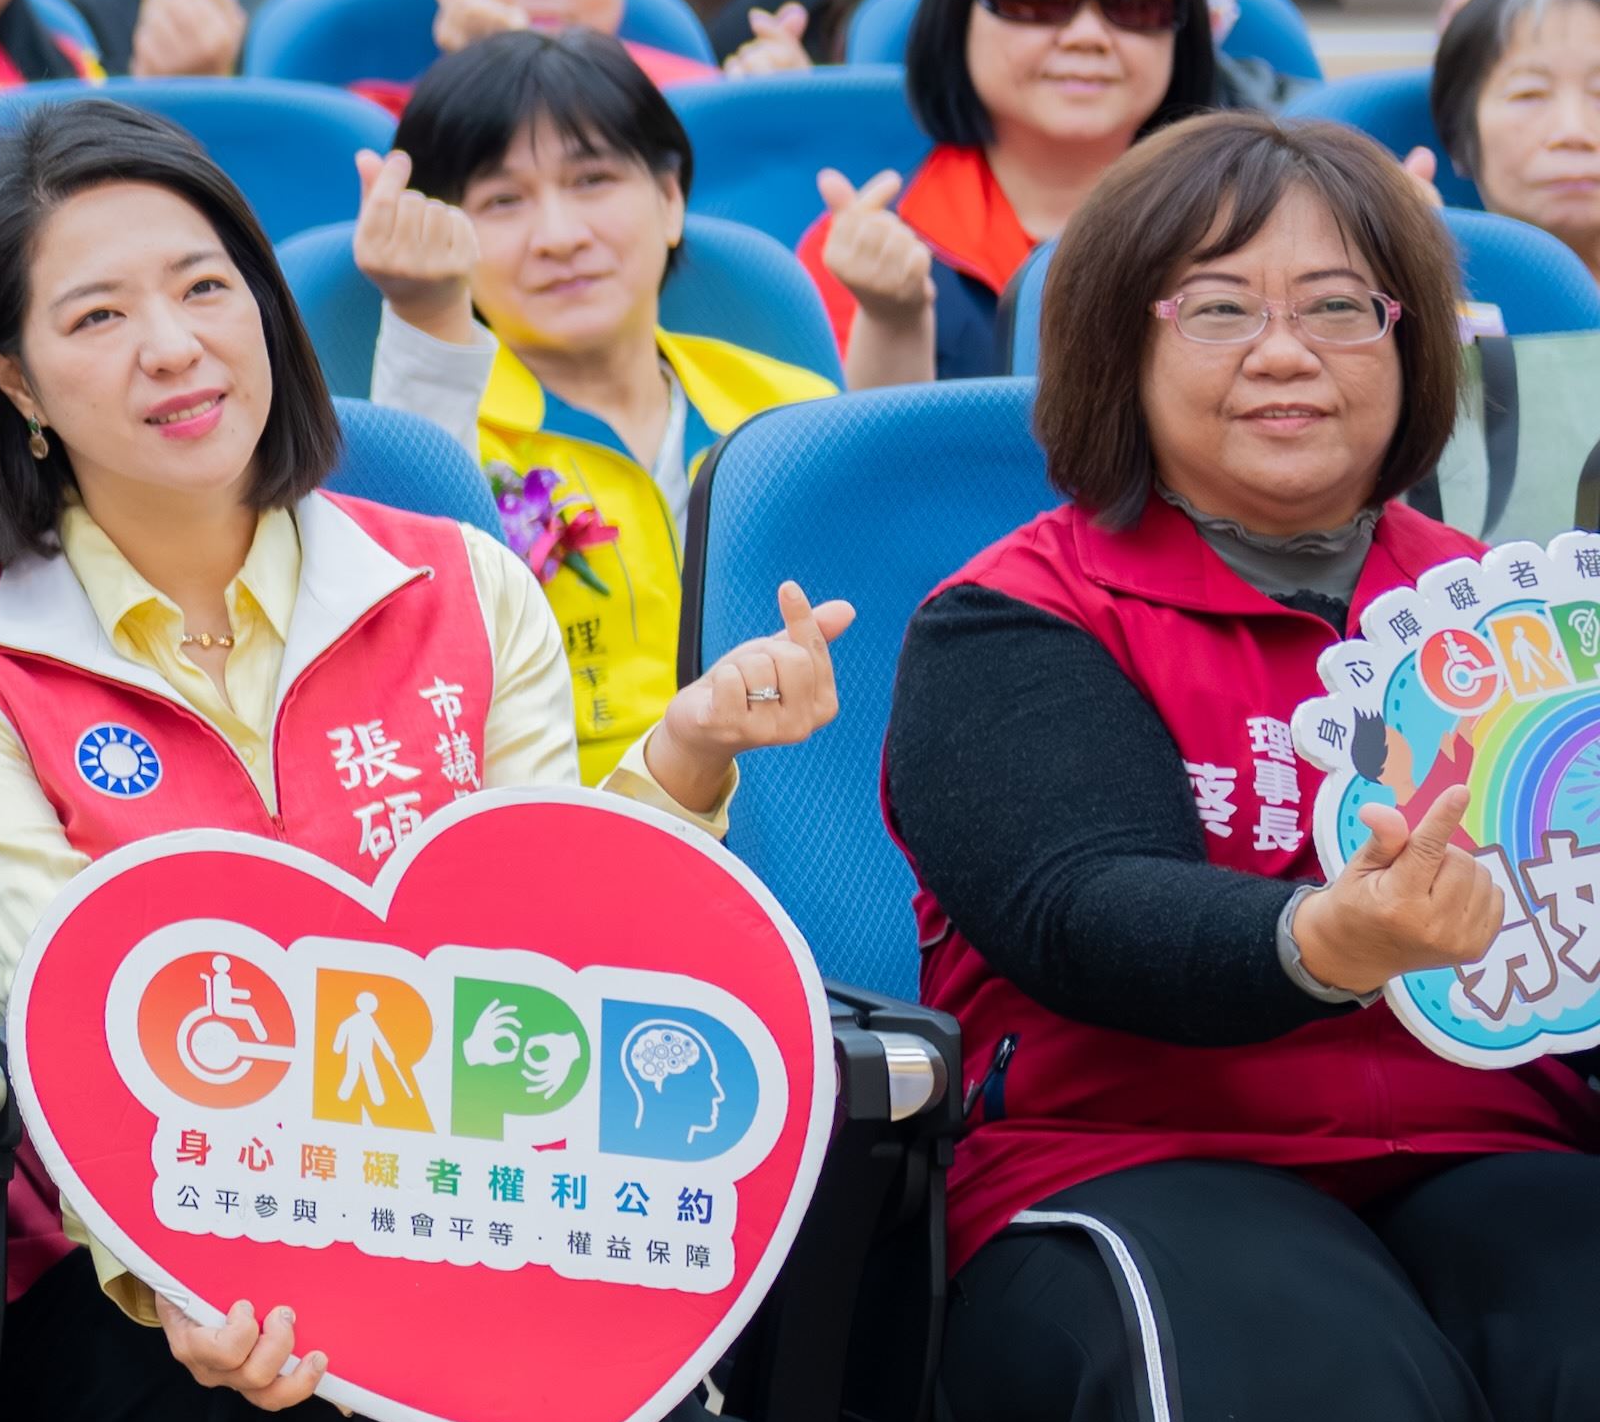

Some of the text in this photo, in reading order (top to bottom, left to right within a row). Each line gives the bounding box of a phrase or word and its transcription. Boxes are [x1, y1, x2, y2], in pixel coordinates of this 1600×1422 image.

[418, 676, 482, 804] 市議
[1246, 716, 1304, 852] 理事長
[137, 951, 760, 1163] CRPD
[176, 1129, 715, 1227] 身心障礙者權利公約
